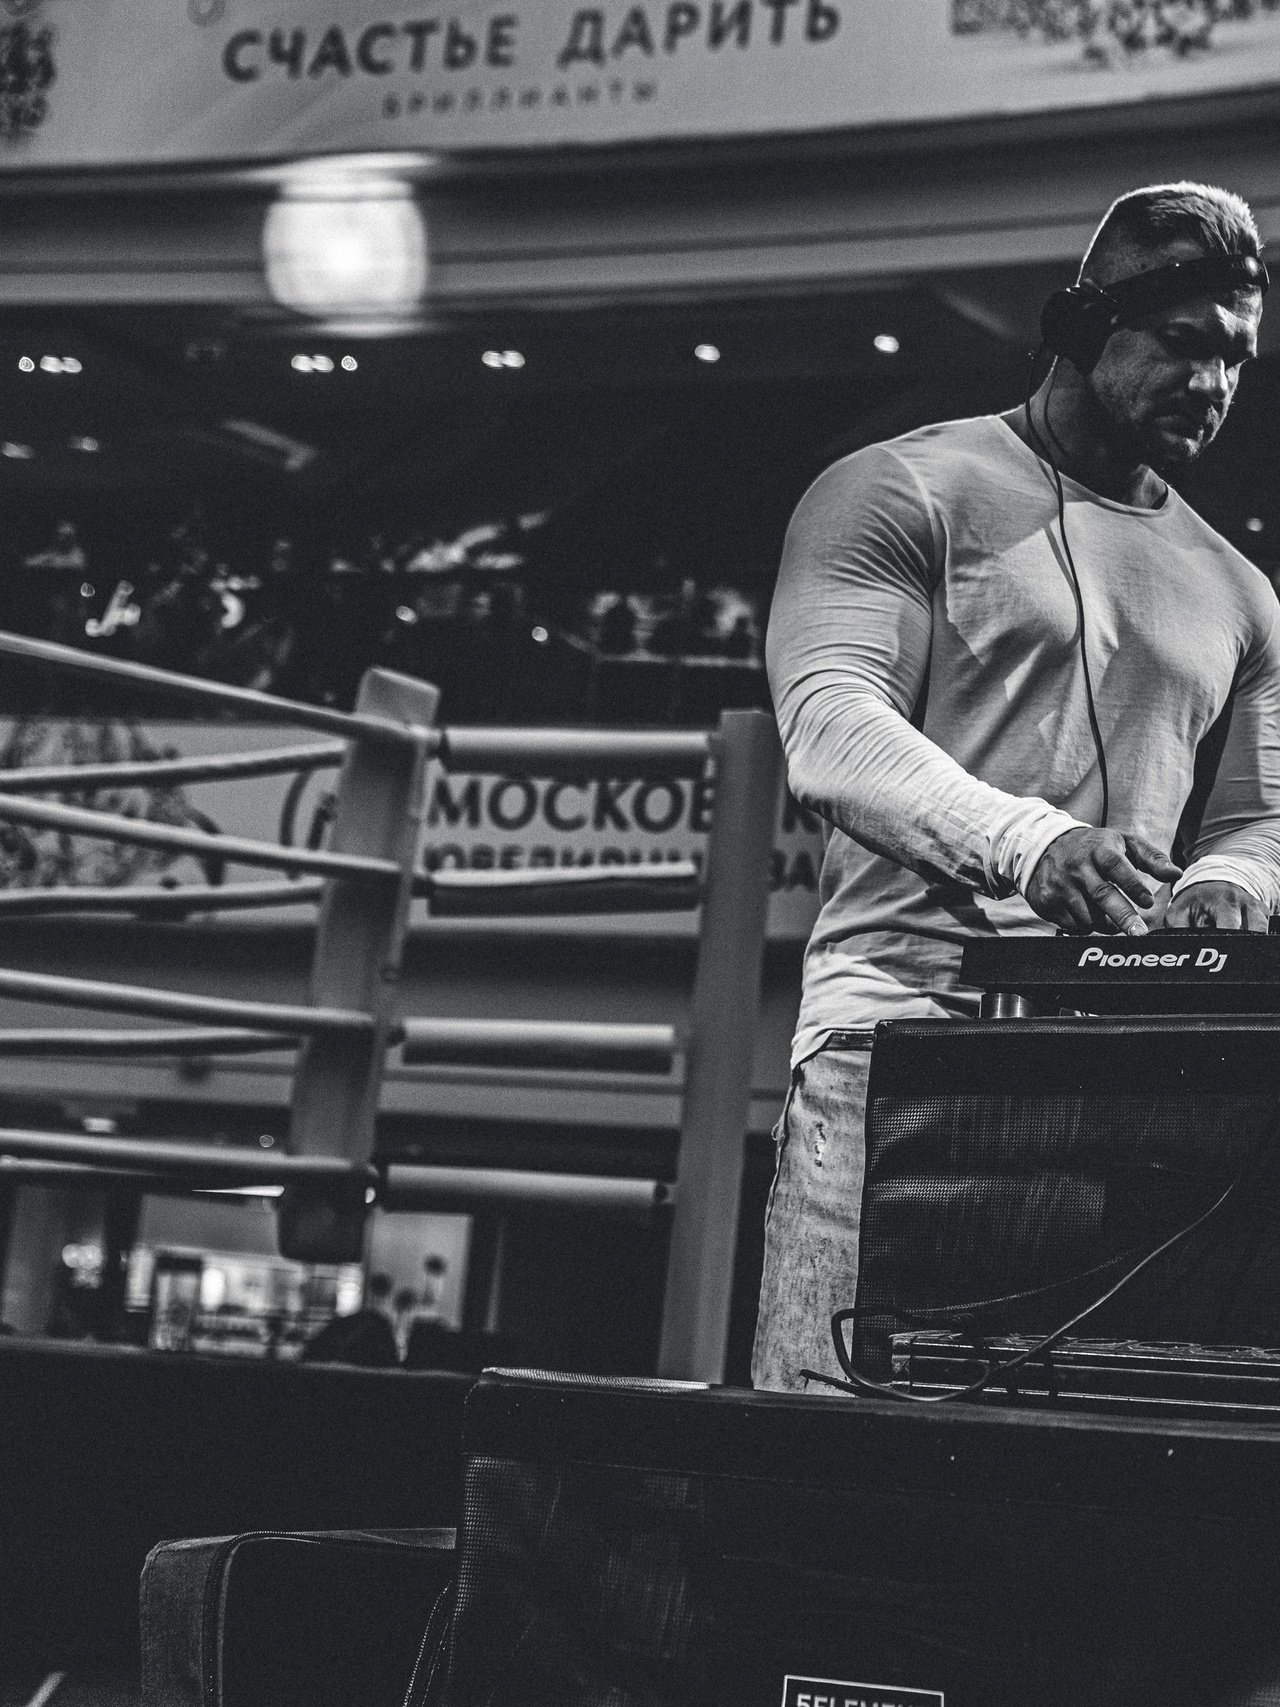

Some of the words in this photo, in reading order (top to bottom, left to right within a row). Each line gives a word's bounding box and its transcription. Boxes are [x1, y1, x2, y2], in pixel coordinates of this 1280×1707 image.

[223, 15, 520, 83] СЧАСТЬЕ
[557, 0, 840, 70] ДАРИТЬ
[1078, 947, 1190, 967] Pioneer
